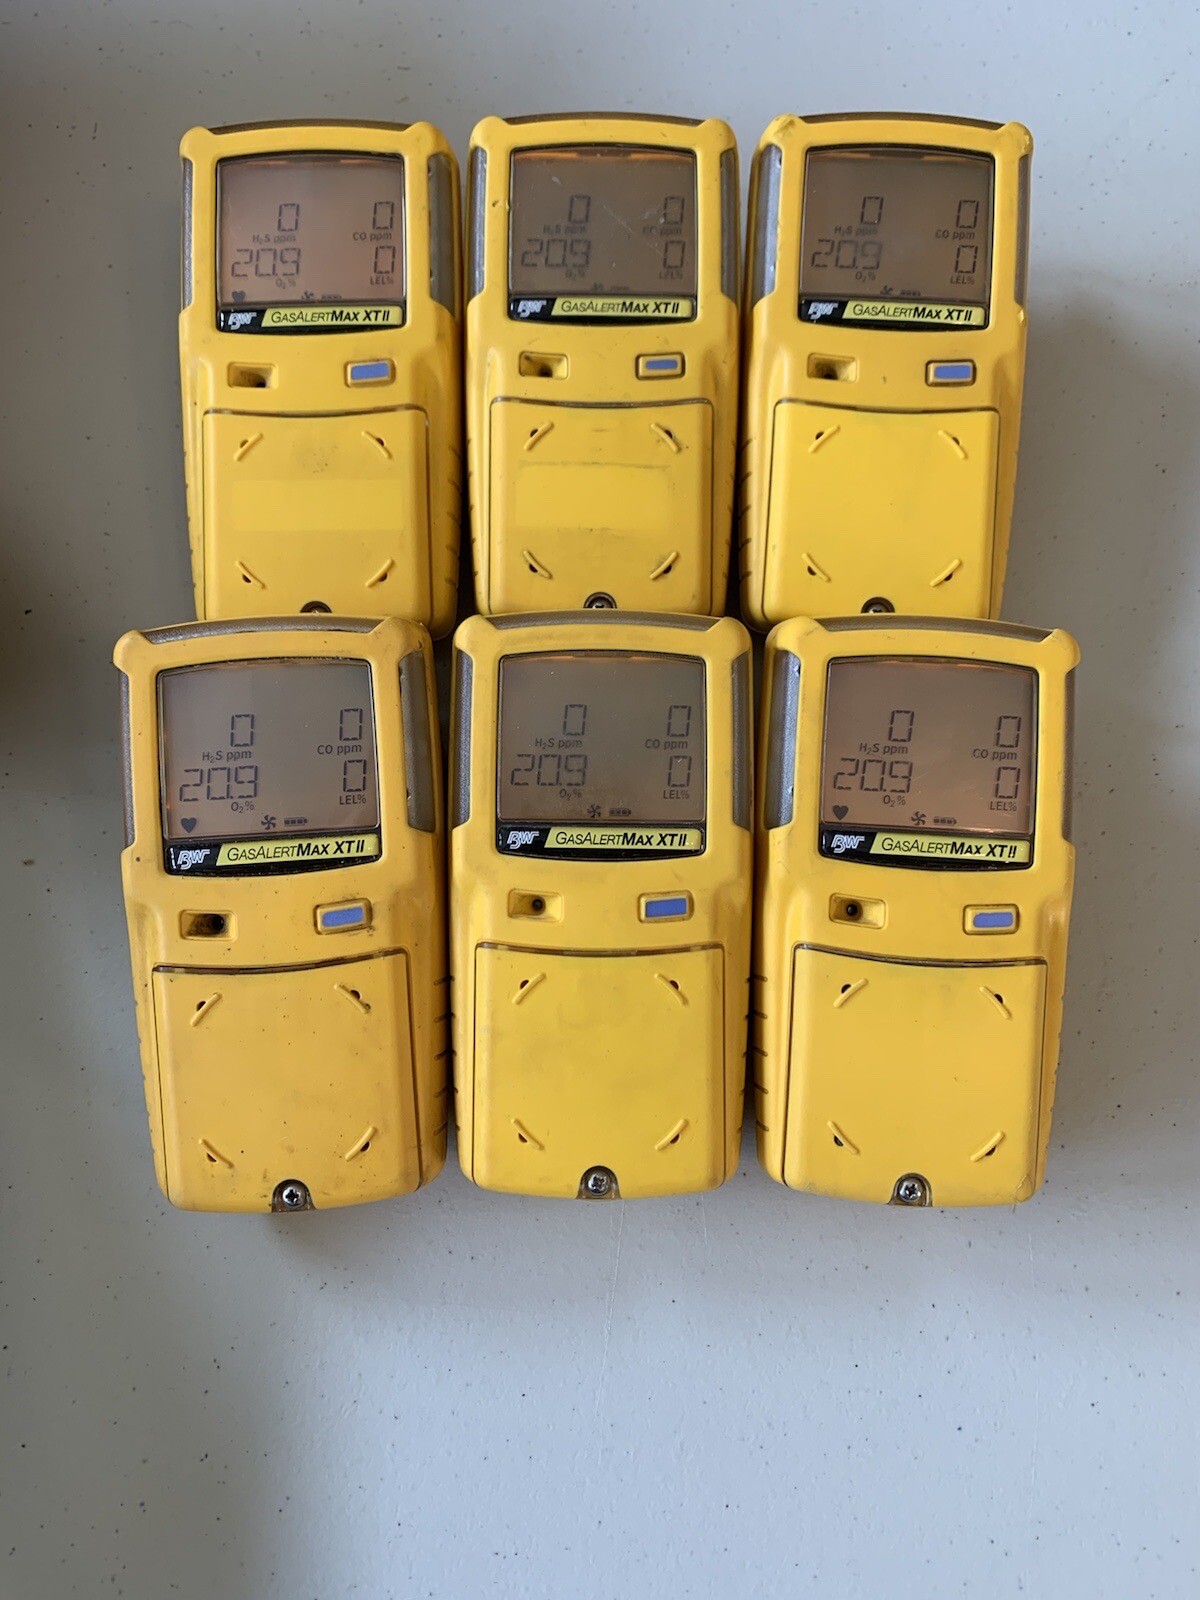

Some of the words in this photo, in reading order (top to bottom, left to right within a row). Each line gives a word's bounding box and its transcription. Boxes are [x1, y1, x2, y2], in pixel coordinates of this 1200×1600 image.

[278, 203, 299, 231] 0
[373, 202, 394, 229] 0
[569, 194, 591, 224] 0
[663, 196, 684, 225] 0
[861, 196, 884, 225] 0
[956, 200, 979, 229] 0
[273, 235, 296, 244] ppm
[353, 233, 366, 241] CO
[370, 233, 392, 242] ppm
[855, 226, 878, 236] ppm
[935, 229, 949, 239] CO
[950, 231, 975, 240] ppm
[374, 246, 395, 274] 0
[663, 240, 685, 269] 0
[954, 245, 978, 274] 0
[230, 713, 254, 747] 0
[339, 708, 363, 741] 0
[563, 704, 587, 735] 0
[667, 705, 692, 737] 0
[889, 709, 915, 742] 0
[996, 715, 1021, 748] 0
[226, 750, 252, 762] ppm
[317, 745, 332, 755] CO
[337, 743, 362, 754] ppm
[558, 739, 583, 748] ppm
[645, 739, 660, 749] CO
[664, 740, 688, 750] ppm
[883, 744, 908, 754] ppm
[972, 748, 988, 759] CO
[992, 751, 1017, 761] ppm
[343, 759, 366, 792] 0
[667, 755, 692, 787] 0
[995, 766, 1021, 799] 0
